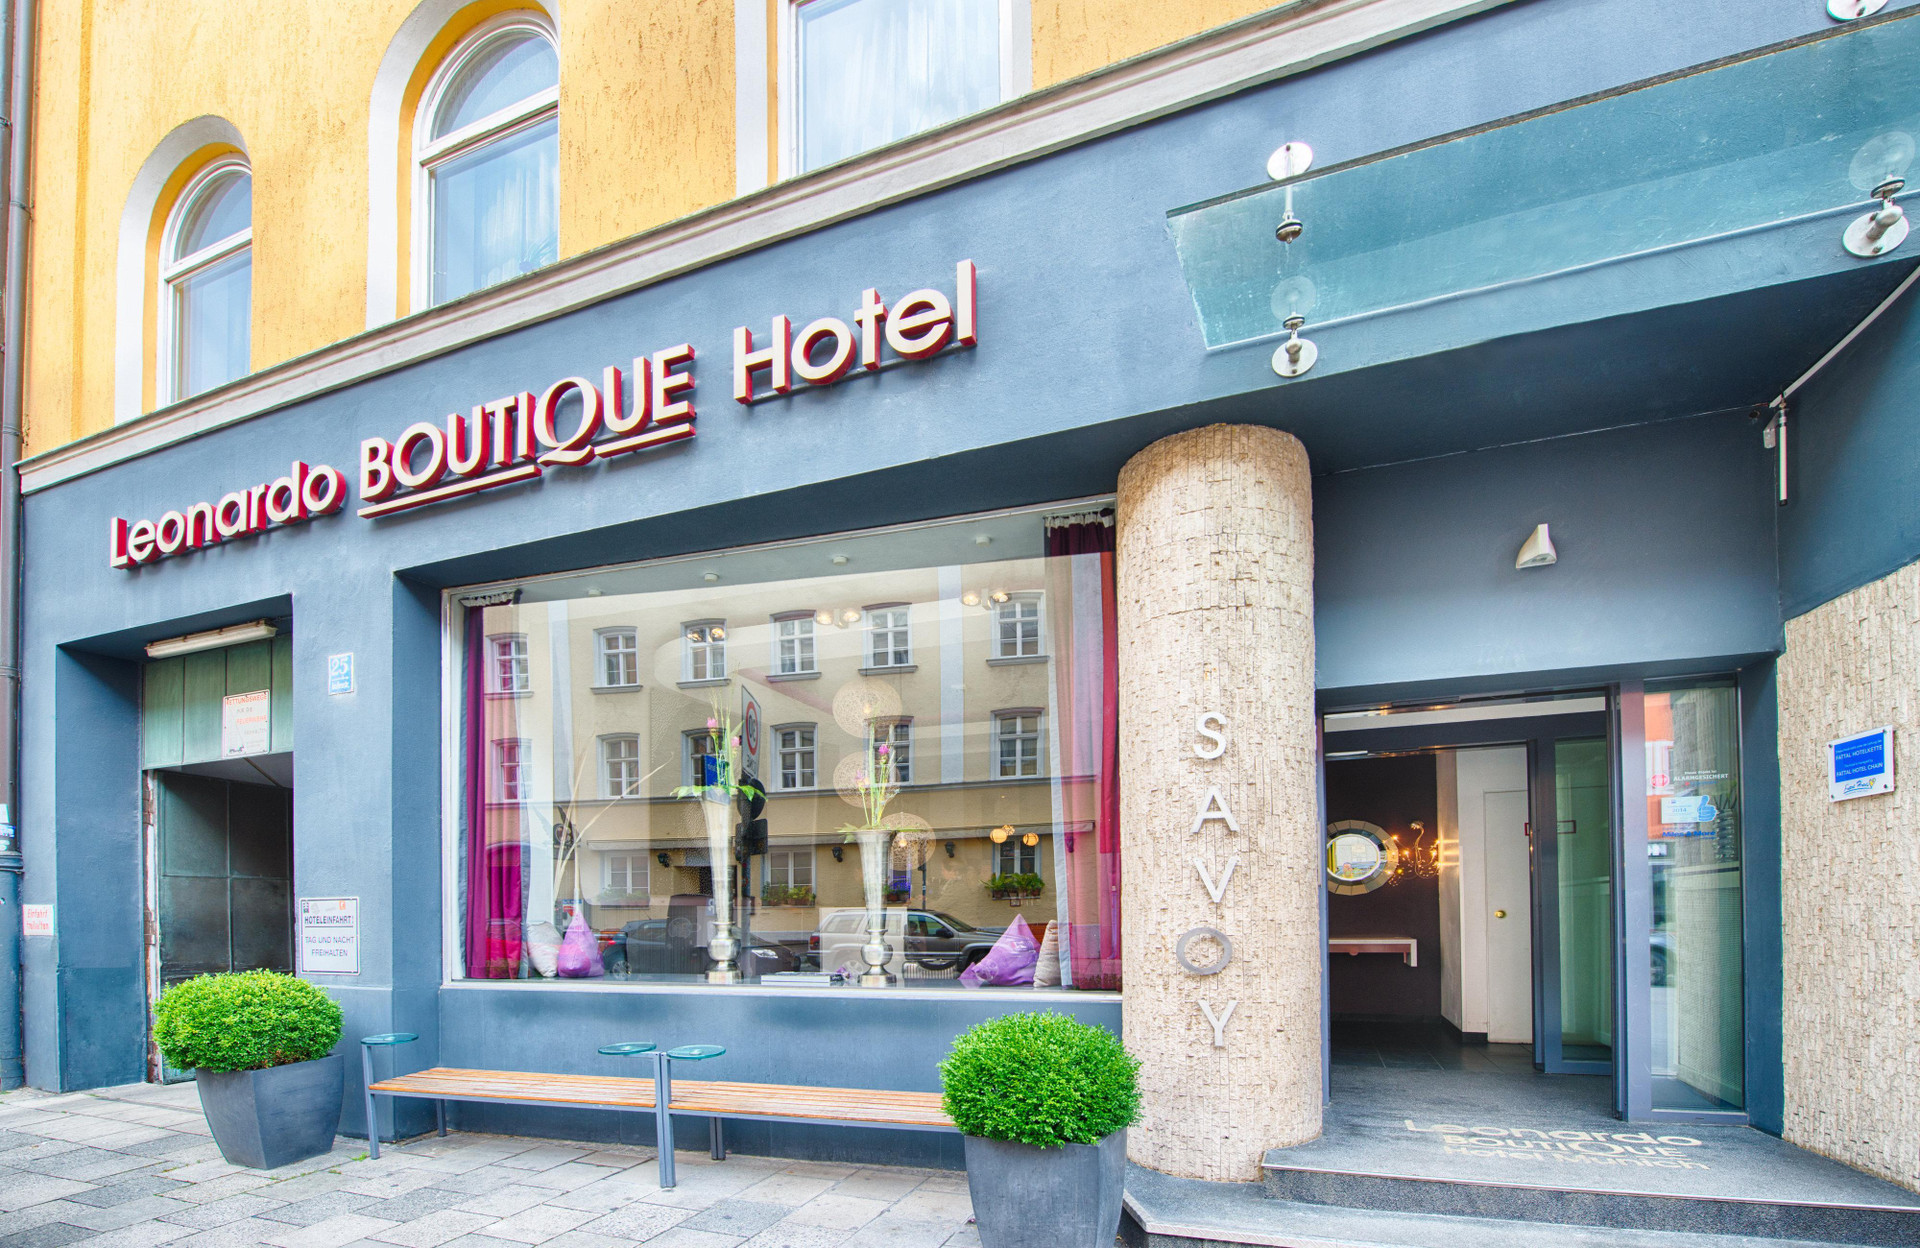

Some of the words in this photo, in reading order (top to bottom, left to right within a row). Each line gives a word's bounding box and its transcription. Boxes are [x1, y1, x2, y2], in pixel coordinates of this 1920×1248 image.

[110, 460, 347, 570] Leonardo
[359, 343, 697, 517] BOUTIQUE
[732, 258, 978, 405] Hotel
[331, 657, 348, 676] 25
[1673, 774, 1728, 782] ALARMGESICHERT
[1176, 711, 1240, 1048] SAVOY
[305, 936, 317, 944] TAG
[318, 936, 332, 944] UND
[333, 936, 355, 944] NACHT
[311, 948, 348, 957] FREIHALTEN
[1404, 1119, 1704, 1147] Leonardo
[1443, 1135, 1689, 1158] BOUTIQUE
[1442, 1146, 1545, 1162] Hotel
[1550, 1152, 1711, 1171] Munich
